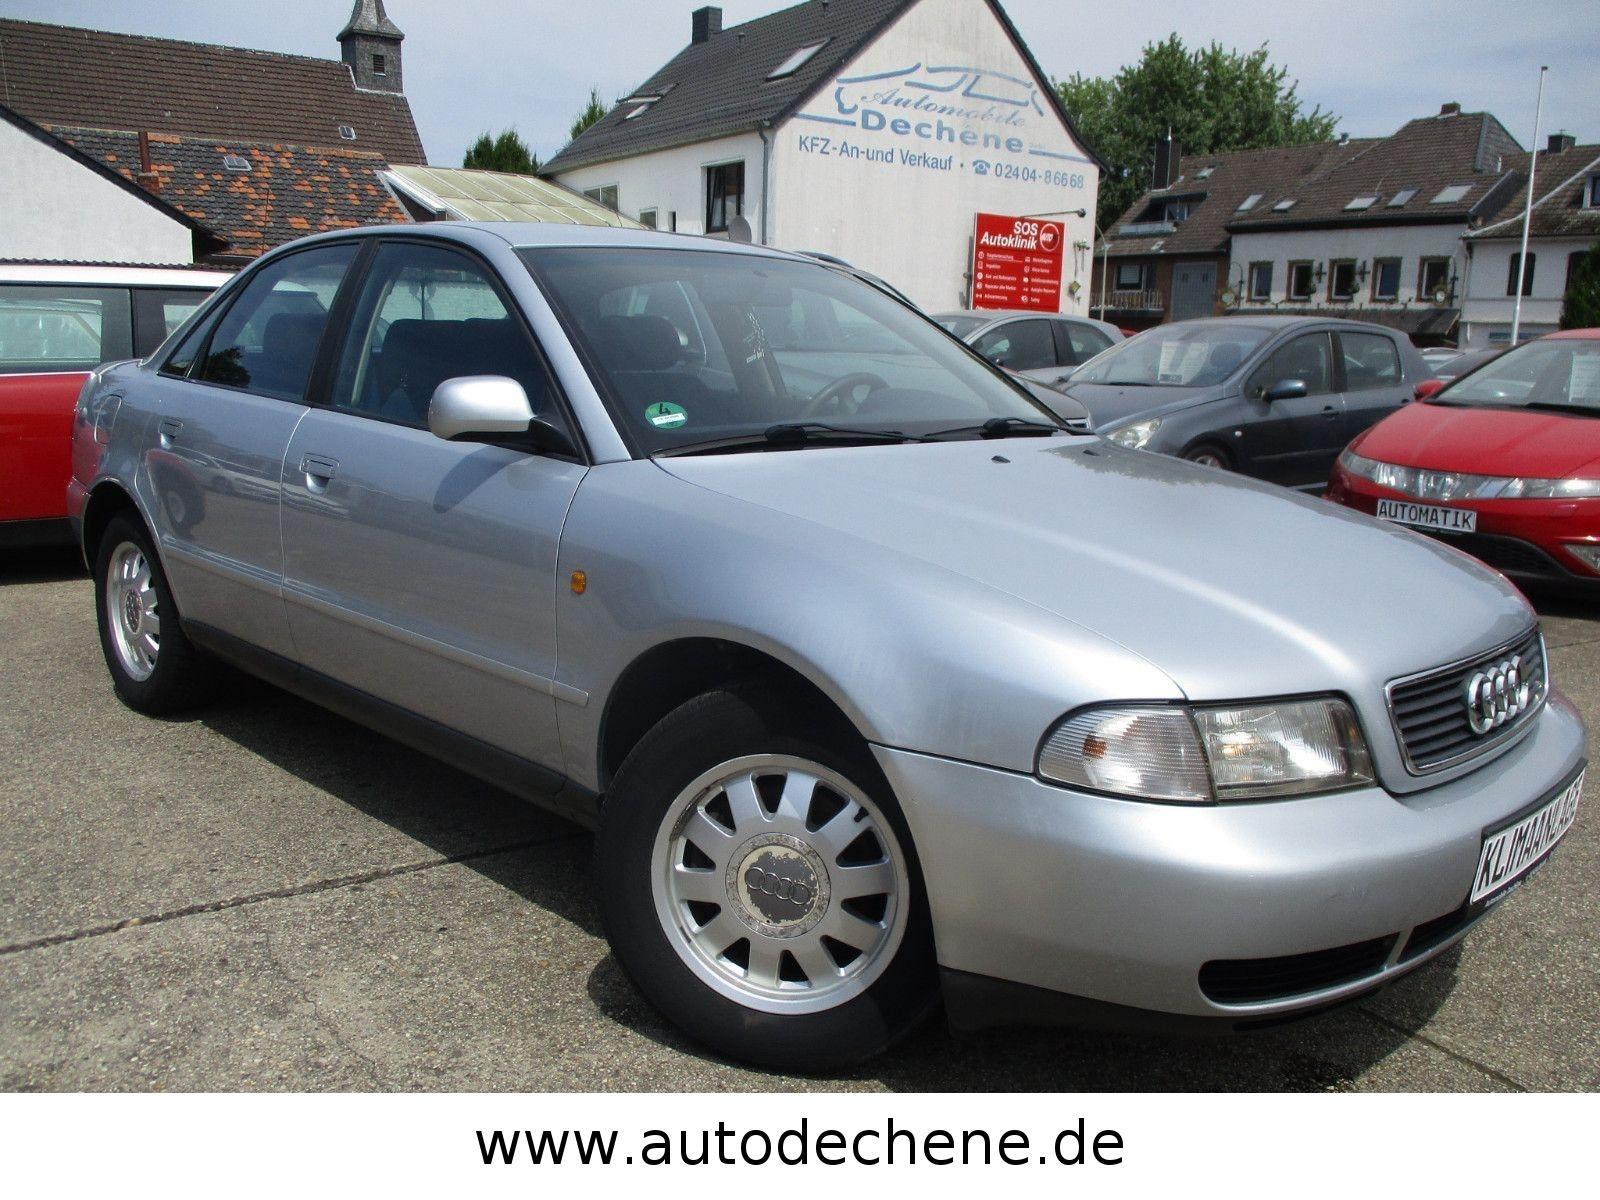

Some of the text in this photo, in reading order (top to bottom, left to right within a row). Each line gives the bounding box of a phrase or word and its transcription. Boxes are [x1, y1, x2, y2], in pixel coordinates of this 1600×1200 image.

[900, 149, 953, 170] Verkauf
[1013, 221, 1038, 236] SOS
[980, 231, 1037, 249] Autoklinik
[1379, 501, 1473, 528] AUTOMATIK
